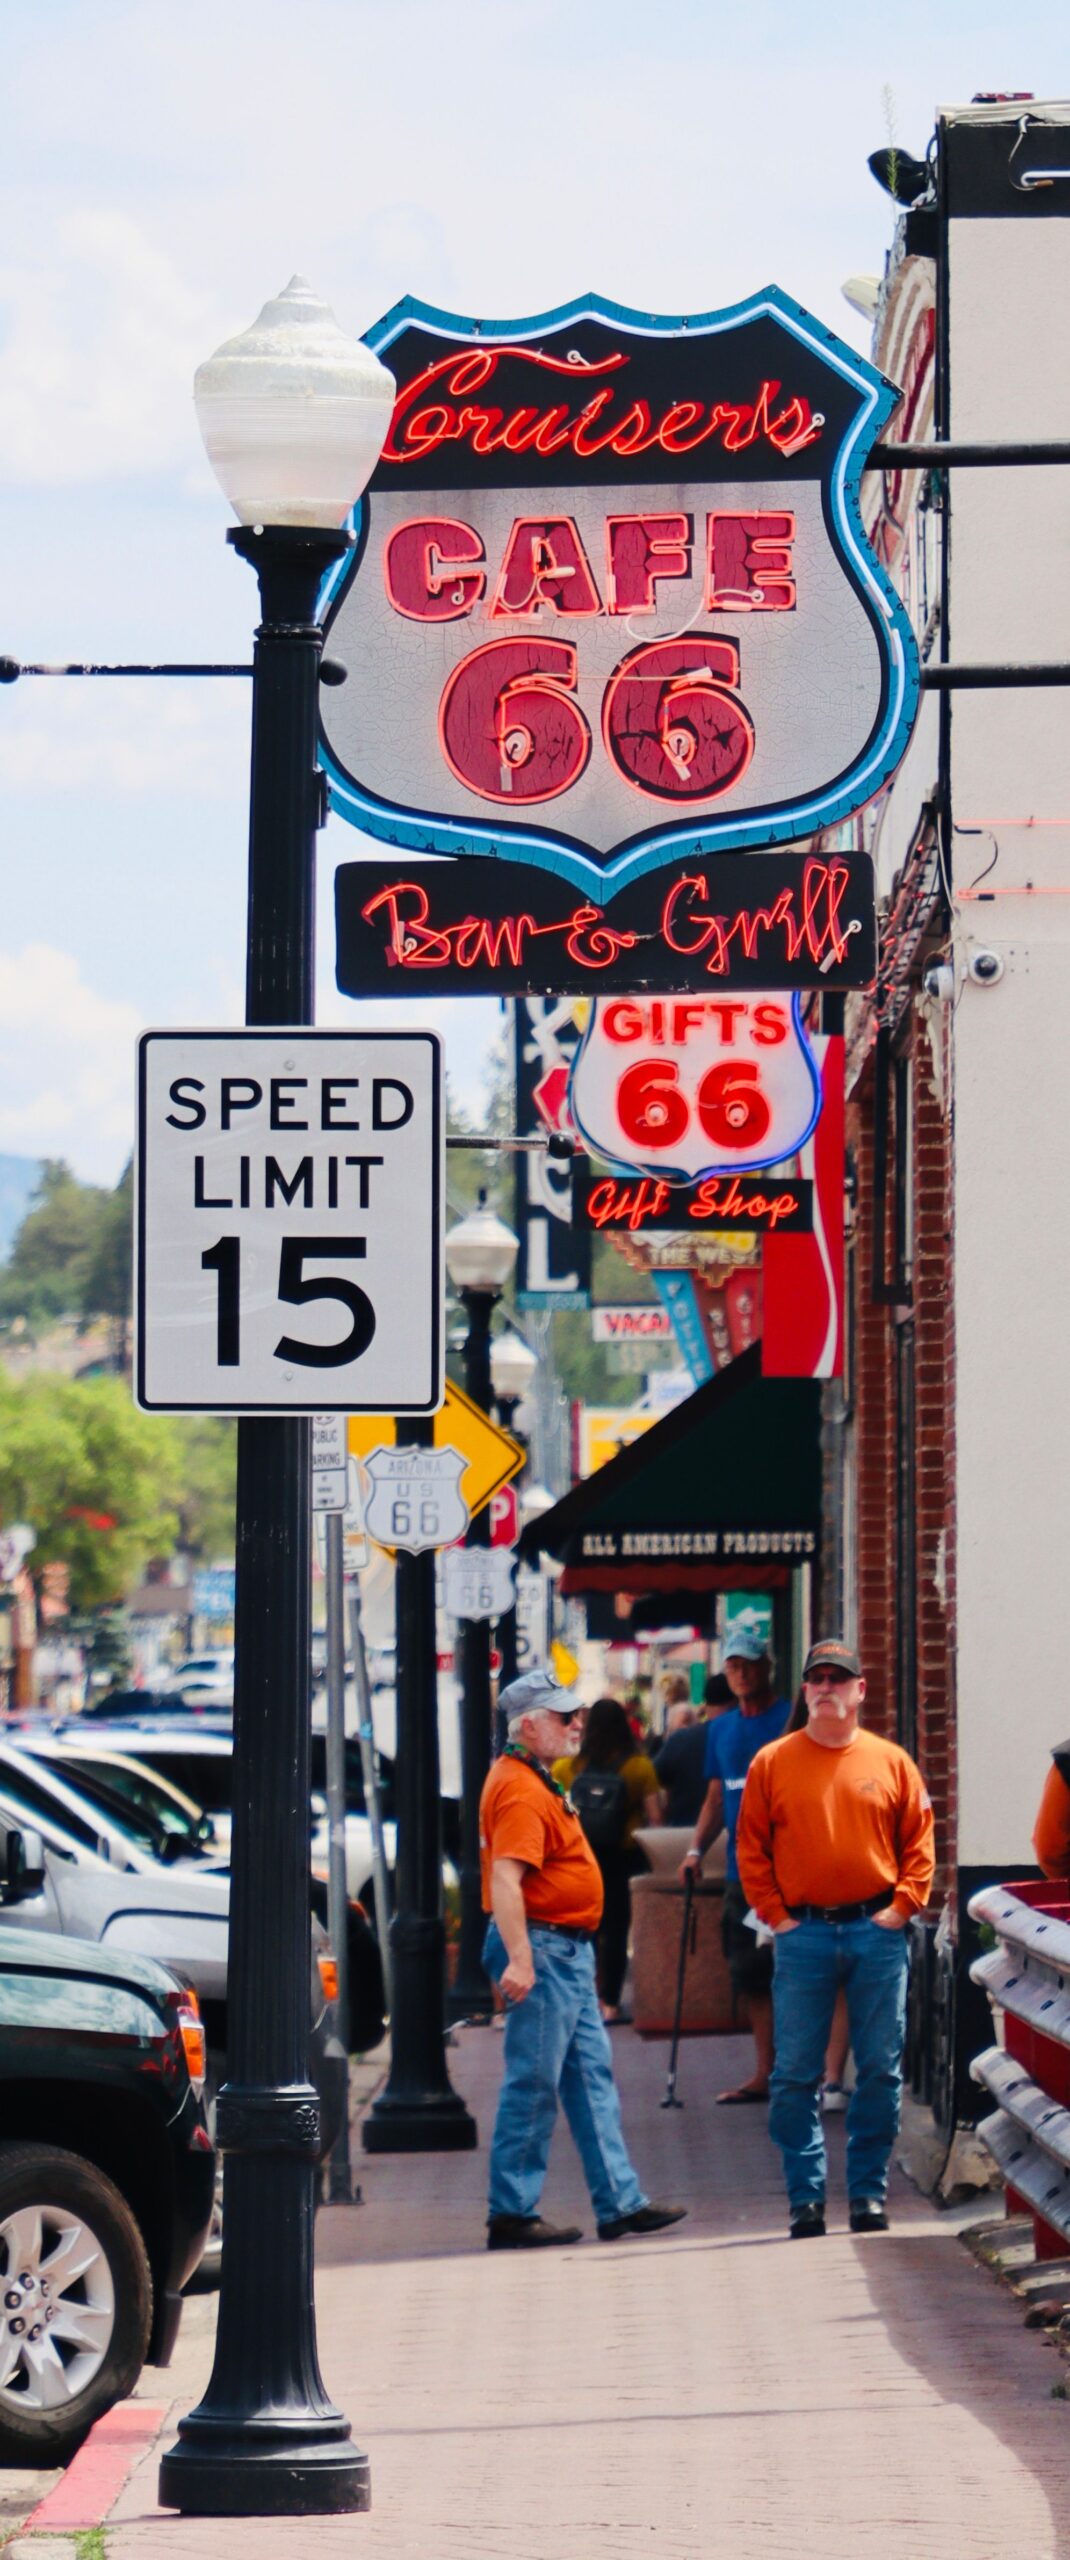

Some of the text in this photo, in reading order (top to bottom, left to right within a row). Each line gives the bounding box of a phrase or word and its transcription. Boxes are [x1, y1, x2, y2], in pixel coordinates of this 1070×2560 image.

[383, 510, 797, 622] CAFE
[438, 630, 757, 807] 66
[361, 856, 850, 975] Bar & Grill
[603, 1001, 788, 1047] GIFTS
[165, 1077, 415, 1131] SPEED
[616, 1058, 773, 1152] 66
[194, 1155, 385, 1209] LIMIT
[586, 1179, 800, 1230] Gift Shop
[649, 1247, 691, 1265] THE
[201, 1236, 377, 1369] 15
[387, 1459, 442, 1477] ARIZONA
[391, 1500, 440, 1537] 66
[583, 1531, 816, 1556] ALL AMERICAN PRODUCTS
